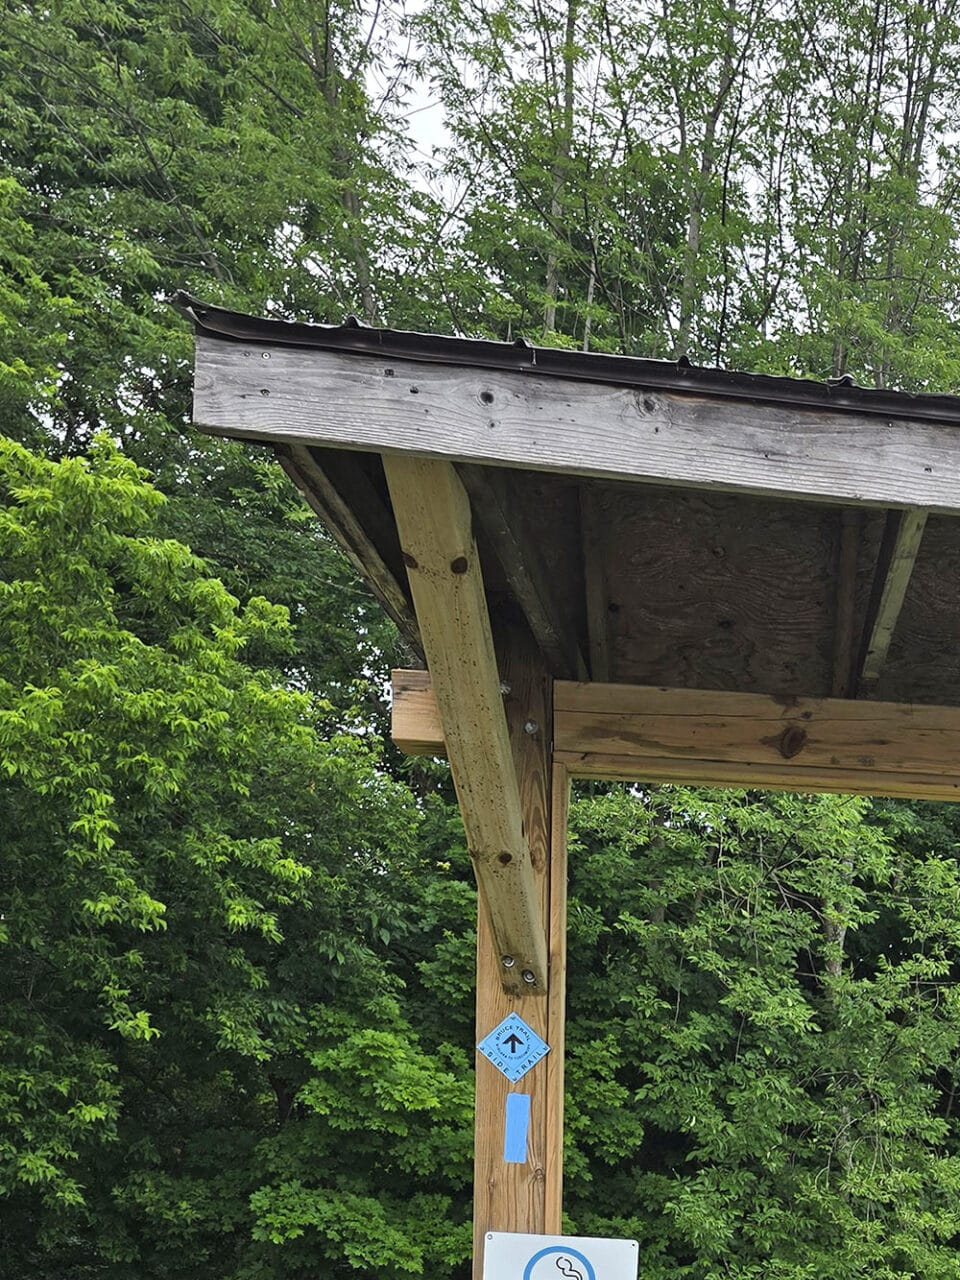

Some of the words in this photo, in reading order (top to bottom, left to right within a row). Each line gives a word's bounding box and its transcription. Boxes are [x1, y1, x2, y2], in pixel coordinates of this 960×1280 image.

[496, 1025, 512, 1040] BRUCE
[516, 1026, 531, 1041] TRAIL
[487, 1051, 509, 1073] SIDE
[516, 1051, 542, 1075] TRAIL
